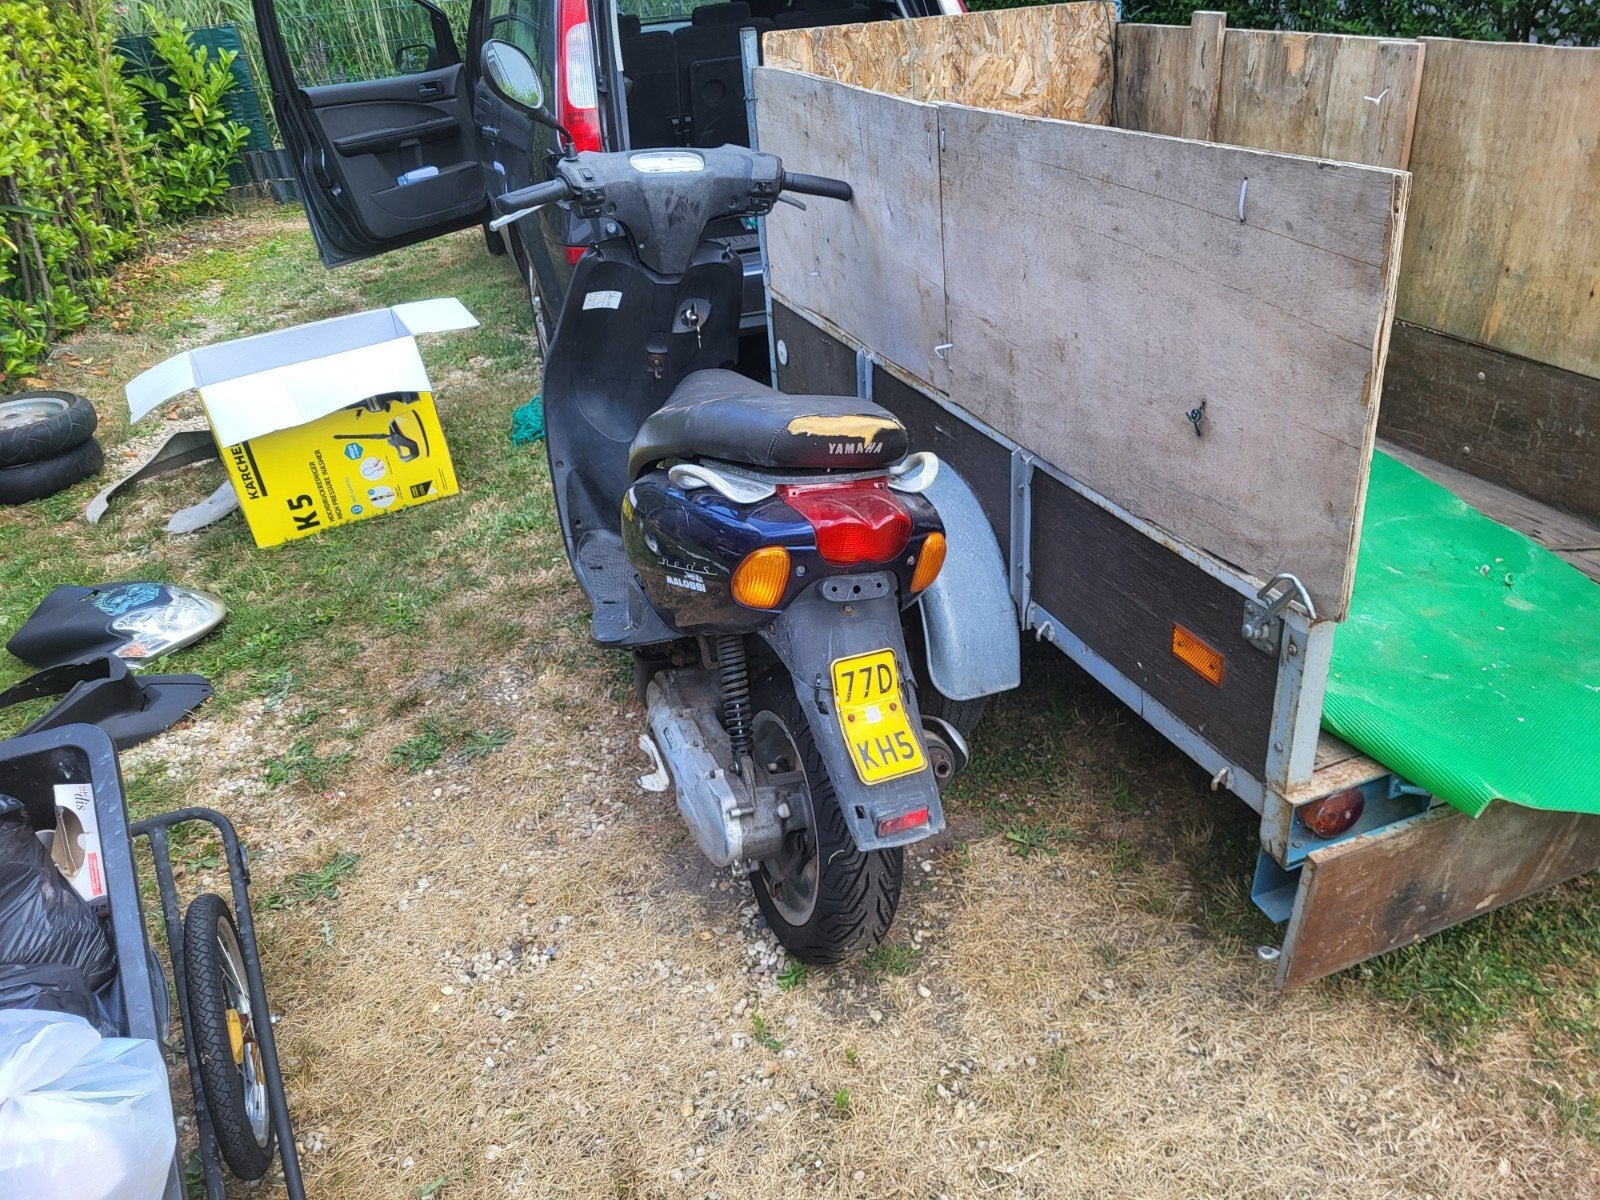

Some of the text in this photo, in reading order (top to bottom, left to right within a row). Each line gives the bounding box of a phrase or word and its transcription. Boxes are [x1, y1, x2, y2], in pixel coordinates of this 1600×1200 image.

[828, 442, 883, 455] YAMAHA
[228, 443, 260, 500] KÄRCHE
[314, 449, 343, 519] HIGH PRESSURE WASHER
[309, 461, 335, 522] HOCHDRUCKREINIGER
[286, 494, 321, 531] K 5
[666, 575, 707, 593] MALOSSI
[841, 664, 893, 702] 77D
[856, 731, 915, 770] KH5
